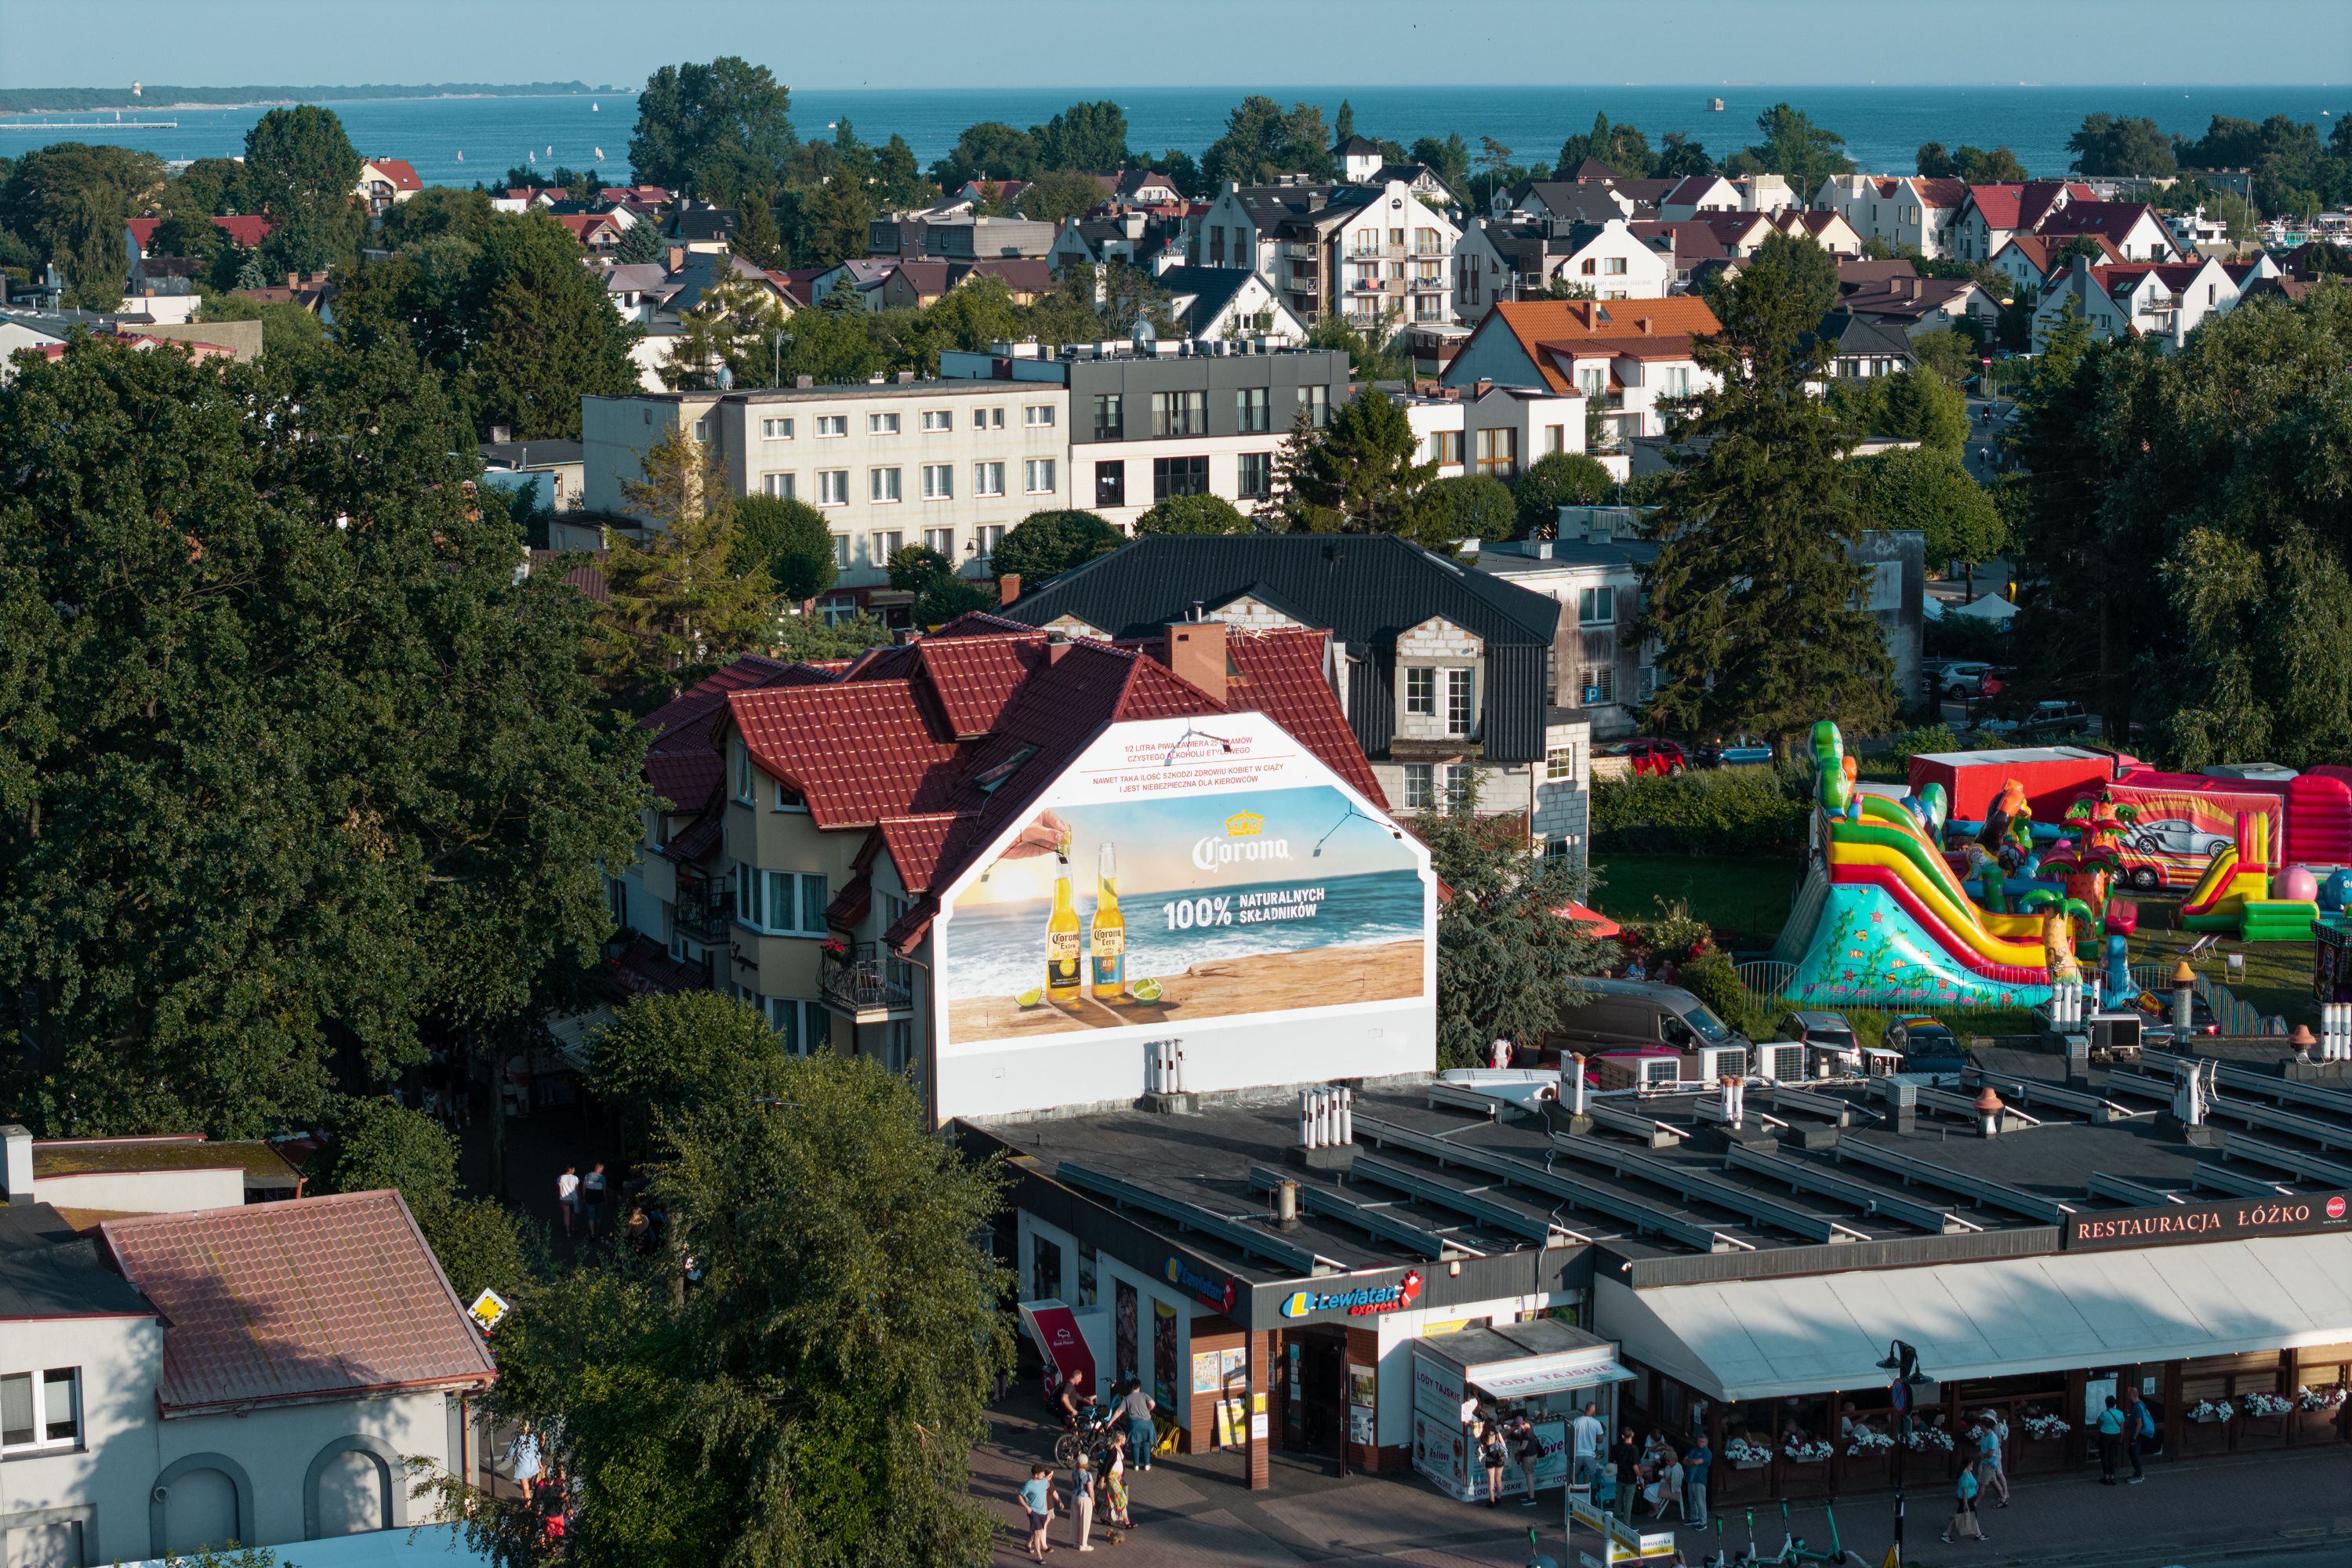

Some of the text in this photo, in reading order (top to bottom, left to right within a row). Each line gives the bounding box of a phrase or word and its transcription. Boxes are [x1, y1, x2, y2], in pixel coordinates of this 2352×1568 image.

[1588, 688, 1598, 701] P
[1127, 746, 1250, 763] CZYSTEGO ALKOHOLU ETYLOWEGO
[1177, 740, 1209, 750] ZAWIERA
[1093, 776, 1118, 785] NAWET
[1140, 771, 1161, 781] ILOŚĆ
[1163, 770, 1192, 779] SZKODZI
[1194, 768, 1226, 777] ZDROWIU
[1228, 765, 1253, 775] KOBIET
[1263, 762, 1284, 772] CIĄŻY
[1123, 783, 1141, 793] JEST
[1142, 780, 1197, 791] NIEBEZPIECZNA
[1198, 779, 1213, 787] DLA
[1214, 775, 1258, 786] KIEROWCÓW
[1192, 836, 1290, 873] Corona
[1163, 887, 1325, 930] 100% NATURALNYCH
[1240, 901, 1317, 924] SKŁADNIKÓW
[1052, 933, 1080, 946] Corona
[1094, 929, 1121, 941] Corona
[2078, 1204, 2310, 1240] RESTAURACJA ŁÓŻKO
[1181, 1267, 1225, 1303] Lewiatan
[1317, 1287, 1398, 1311] Lewiatan
[1348, 1301, 1399, 1316] express
[1489, 1376, 1536, 1388] LODY
[1538, 1364, 1613, 1380] TAJSKIE
[1417, 1371, 1433, 1387] LODY
[1435, 1381, 1461, 1403] TAJSKIE
[1429, 1447, 1450, 1461] Rollove
[1474, 1488, 1488, 1497] LOD
